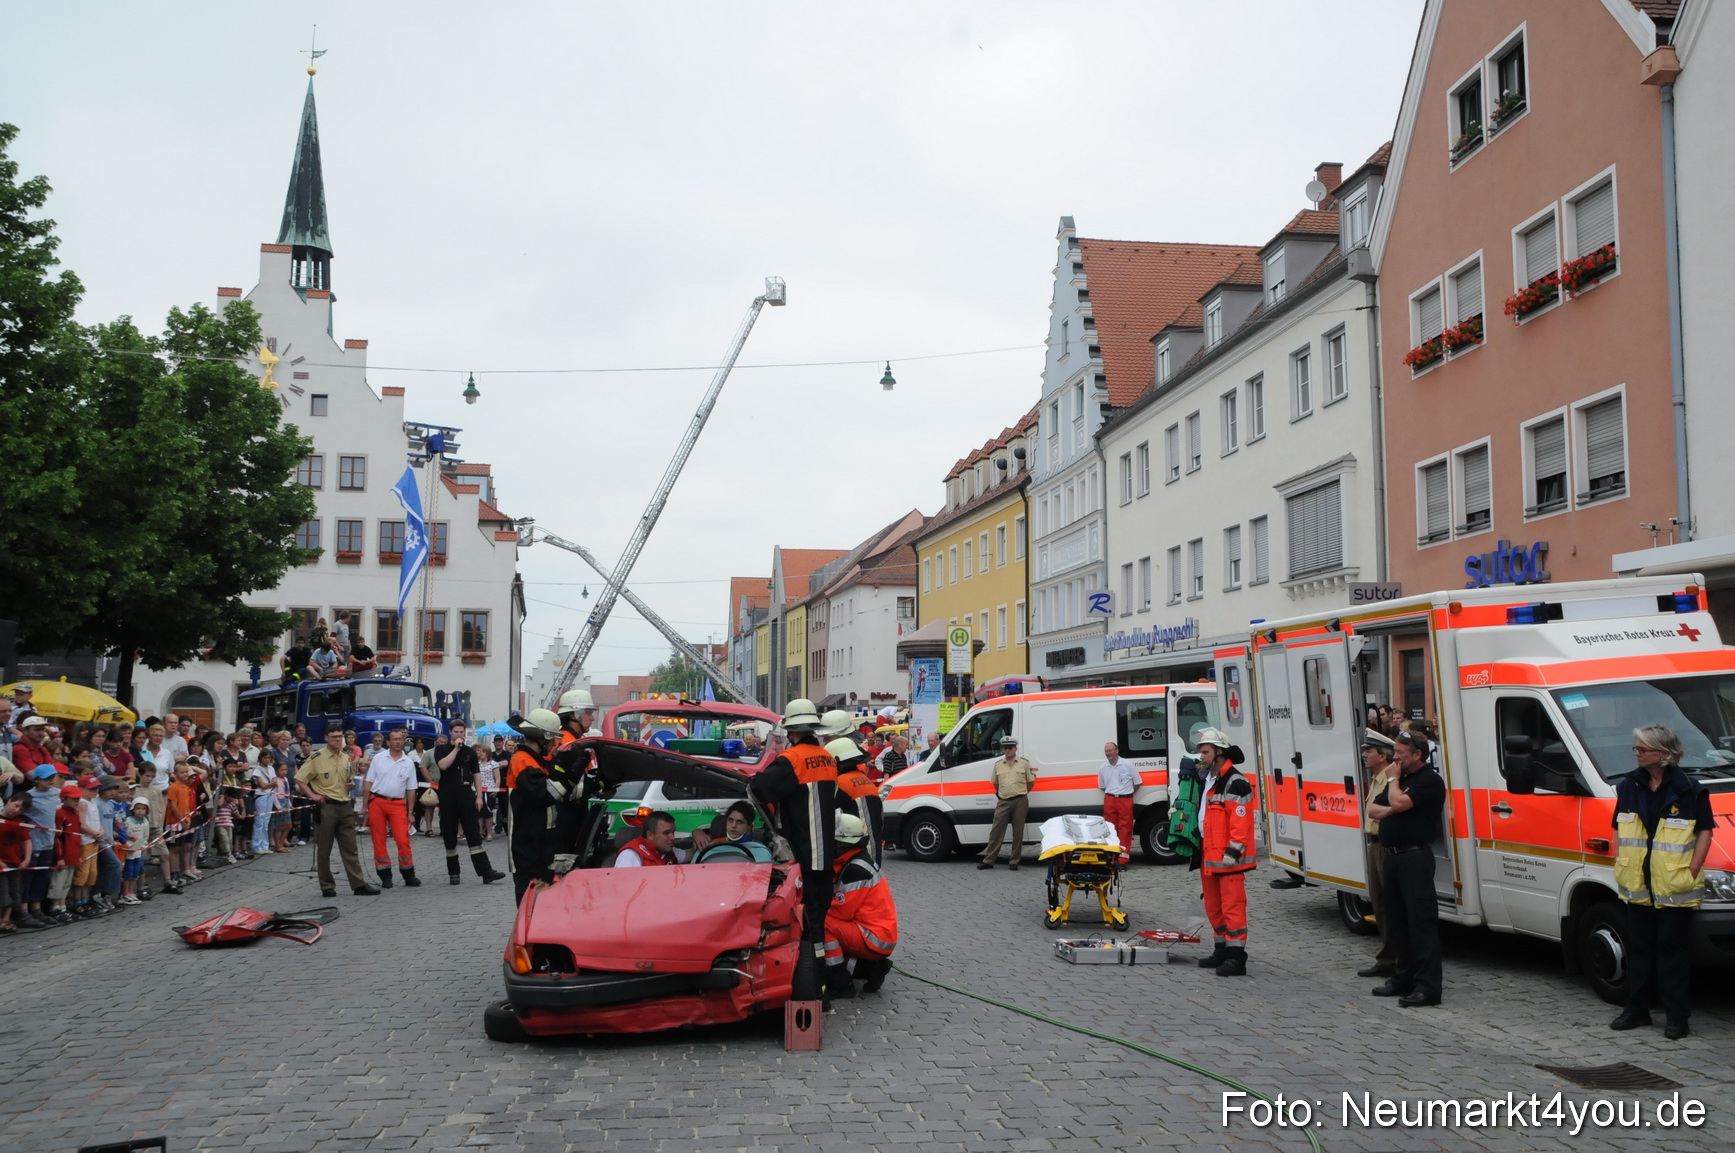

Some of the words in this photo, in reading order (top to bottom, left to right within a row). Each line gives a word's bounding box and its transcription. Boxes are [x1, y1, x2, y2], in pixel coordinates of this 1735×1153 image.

[1353, 585, 1399, 601] sutor
[1153, 617, 1195, 648] Rupprecht
[1573, 632, 1624, 646] Bayerisches
[1623, 630, 1649, 640] Rotes
[1648, 628, 1676, 638] Kreuz
[1320, 796, 1328, 810] 19
[1330, 797, 1345, 812] 222
